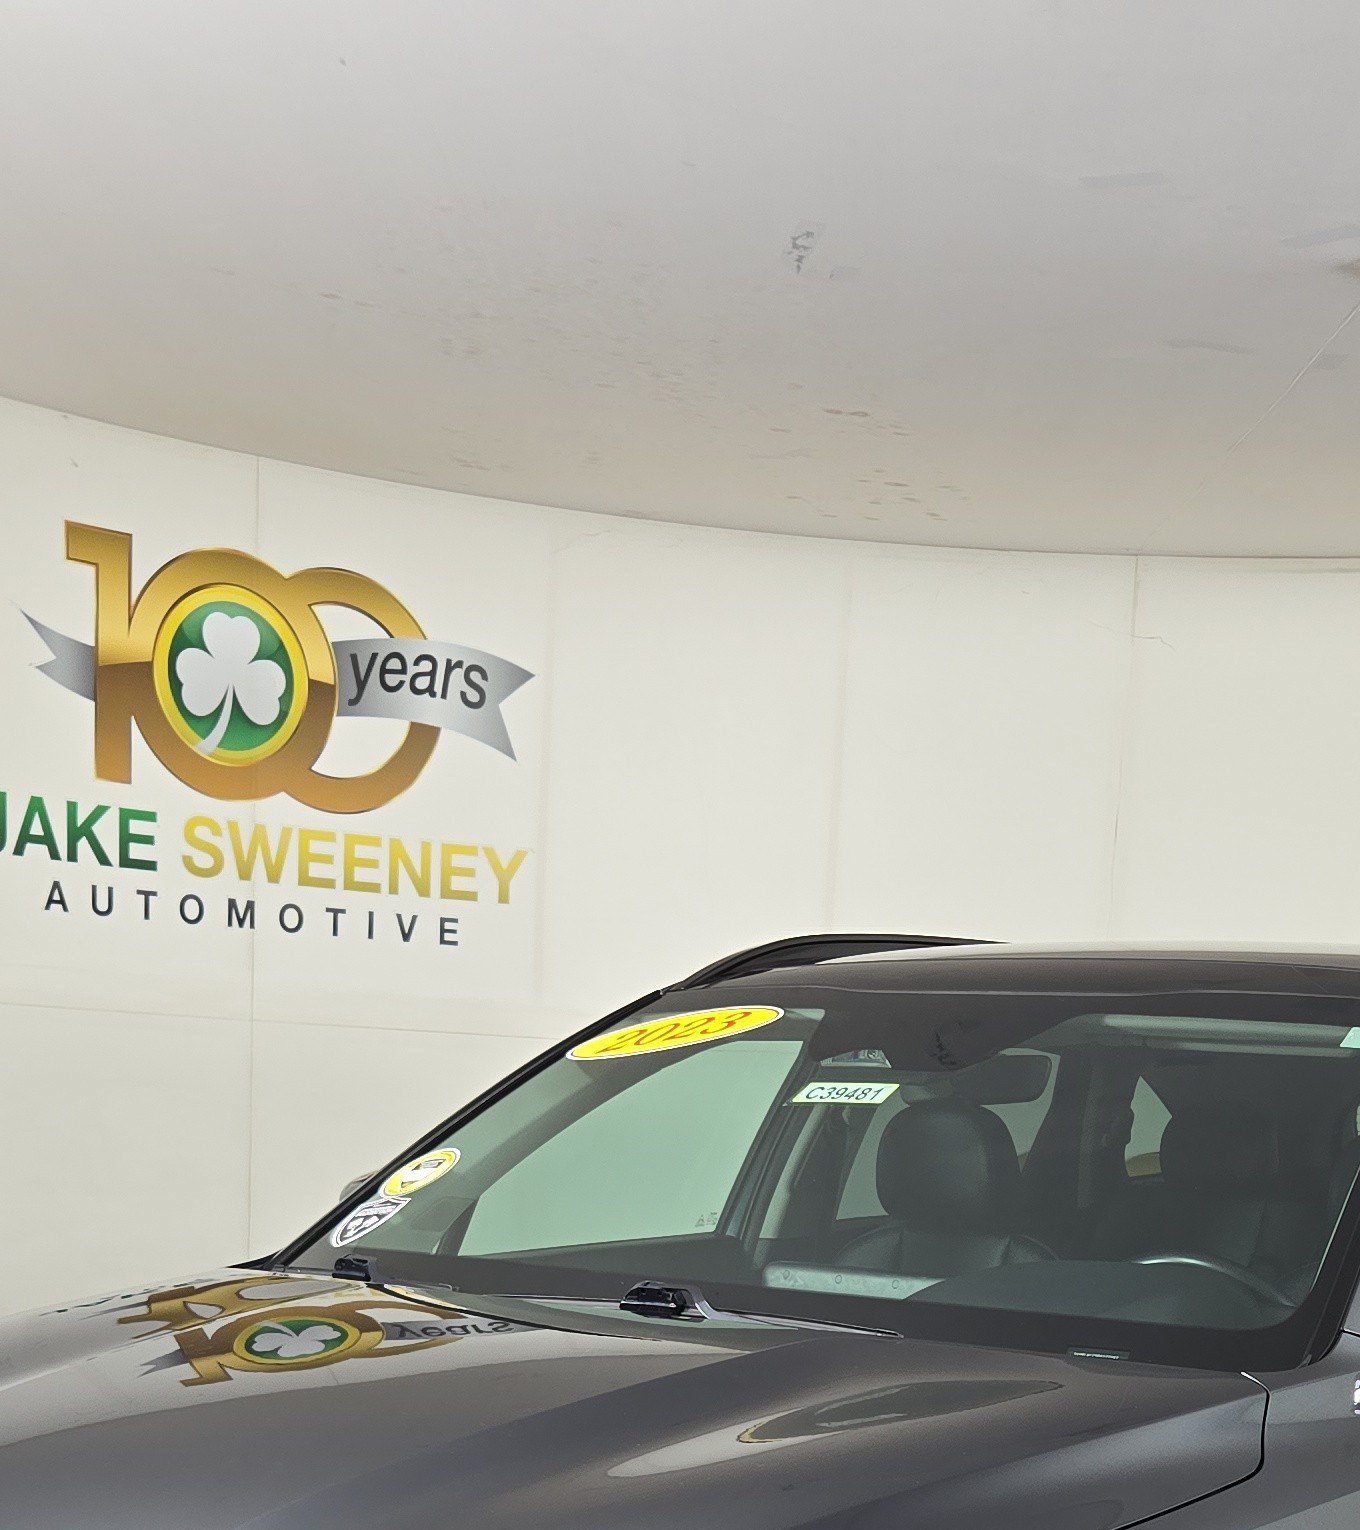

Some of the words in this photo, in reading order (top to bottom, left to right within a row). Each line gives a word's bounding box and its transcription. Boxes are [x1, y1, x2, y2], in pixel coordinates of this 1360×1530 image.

[64, 519, 441, 814] 100
[348, 651, 488, 710] years
[181, 815, 528, 905] SWEENEY
[44, 880, 460, 946] AUTOMOTIVE
[595, 1011, 753, 1055] 2023
[805, 1086, 884, 1101] C39481
